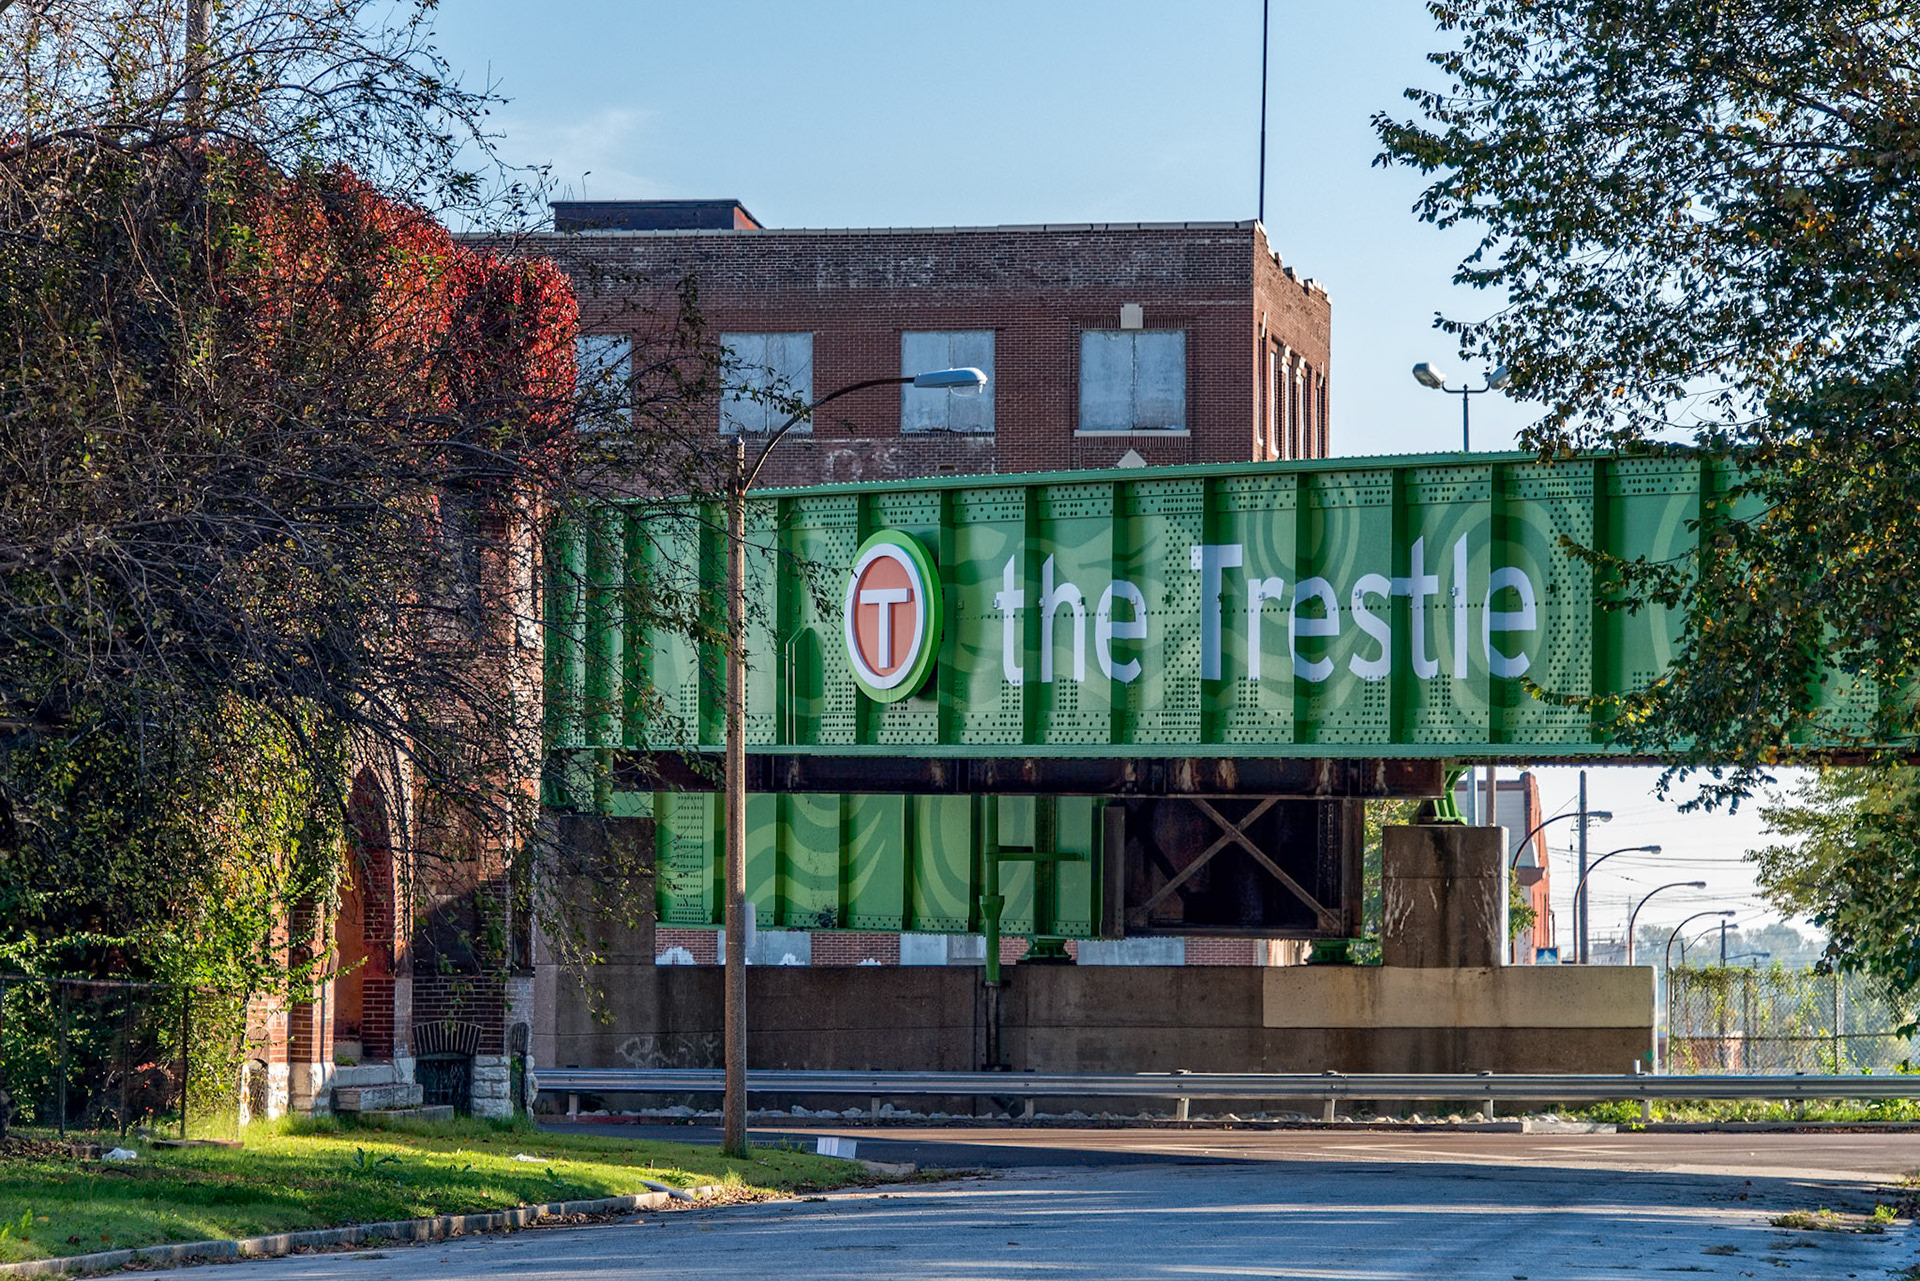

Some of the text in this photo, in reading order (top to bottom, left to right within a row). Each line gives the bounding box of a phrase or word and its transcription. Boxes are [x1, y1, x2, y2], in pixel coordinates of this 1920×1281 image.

[860, 588, 910, 669] T
[994, 531, 1537, 685] the Trestle
